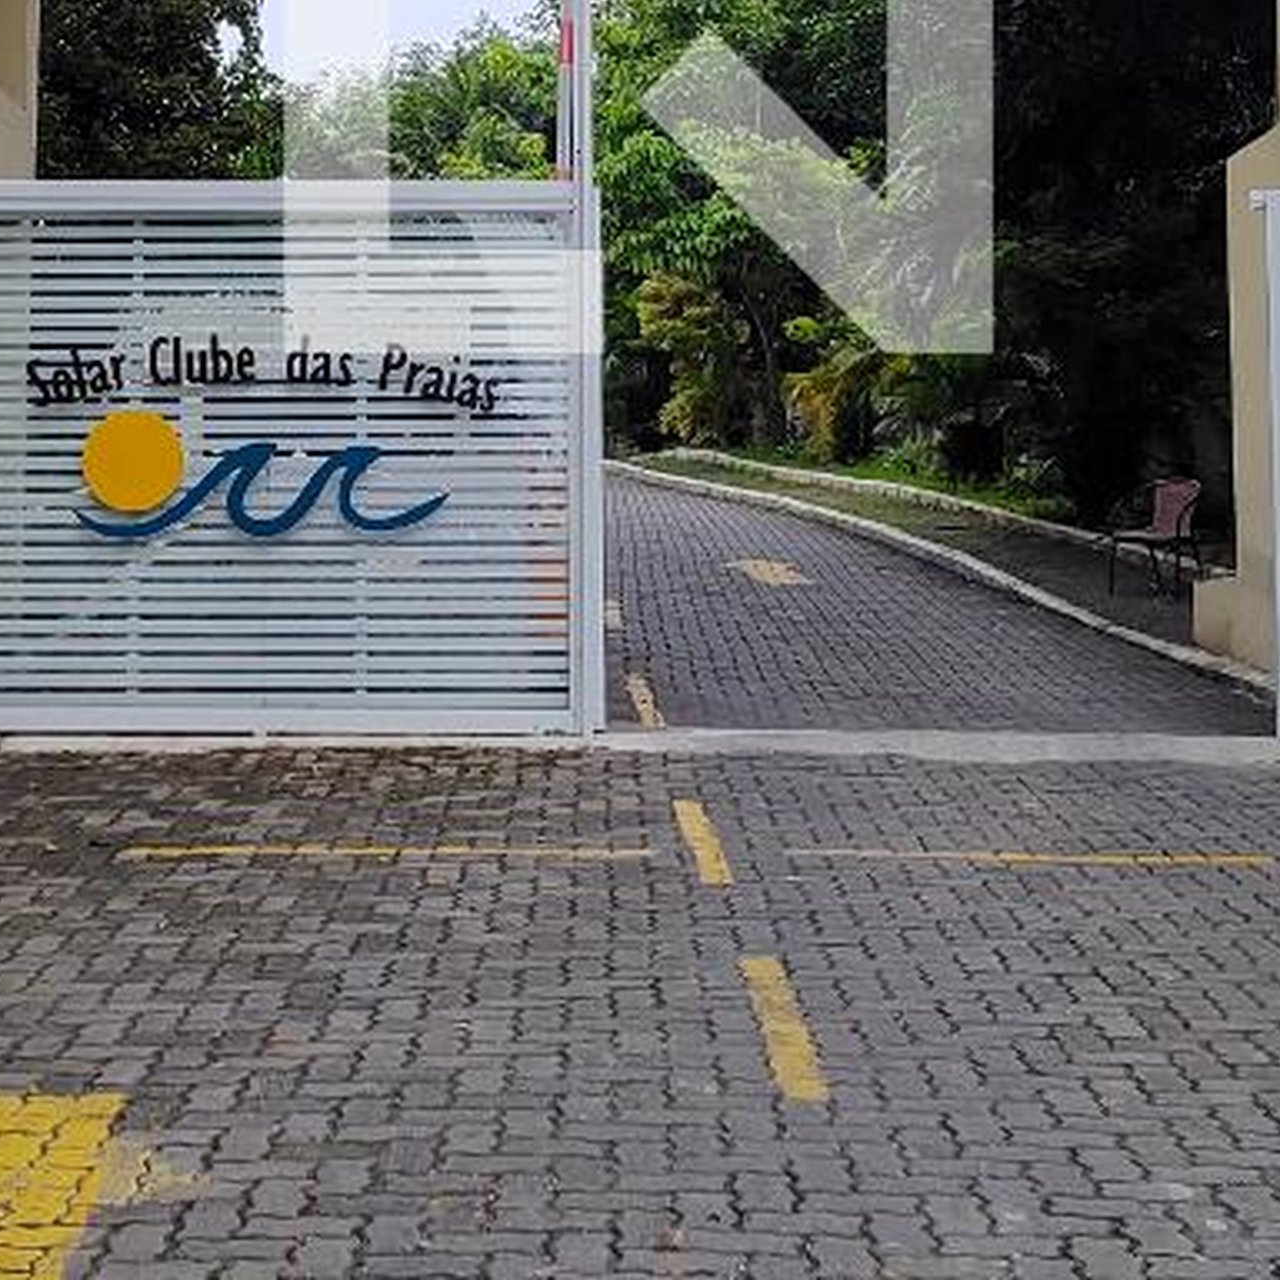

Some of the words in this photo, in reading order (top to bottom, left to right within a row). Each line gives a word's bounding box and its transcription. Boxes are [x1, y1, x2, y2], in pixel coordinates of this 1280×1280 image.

[26, 348, 125, 407] Solar
[149, 333, 256, 387] Clube
[285, 333, 353, 387] das
[378, 344, 501, 412] Praias
